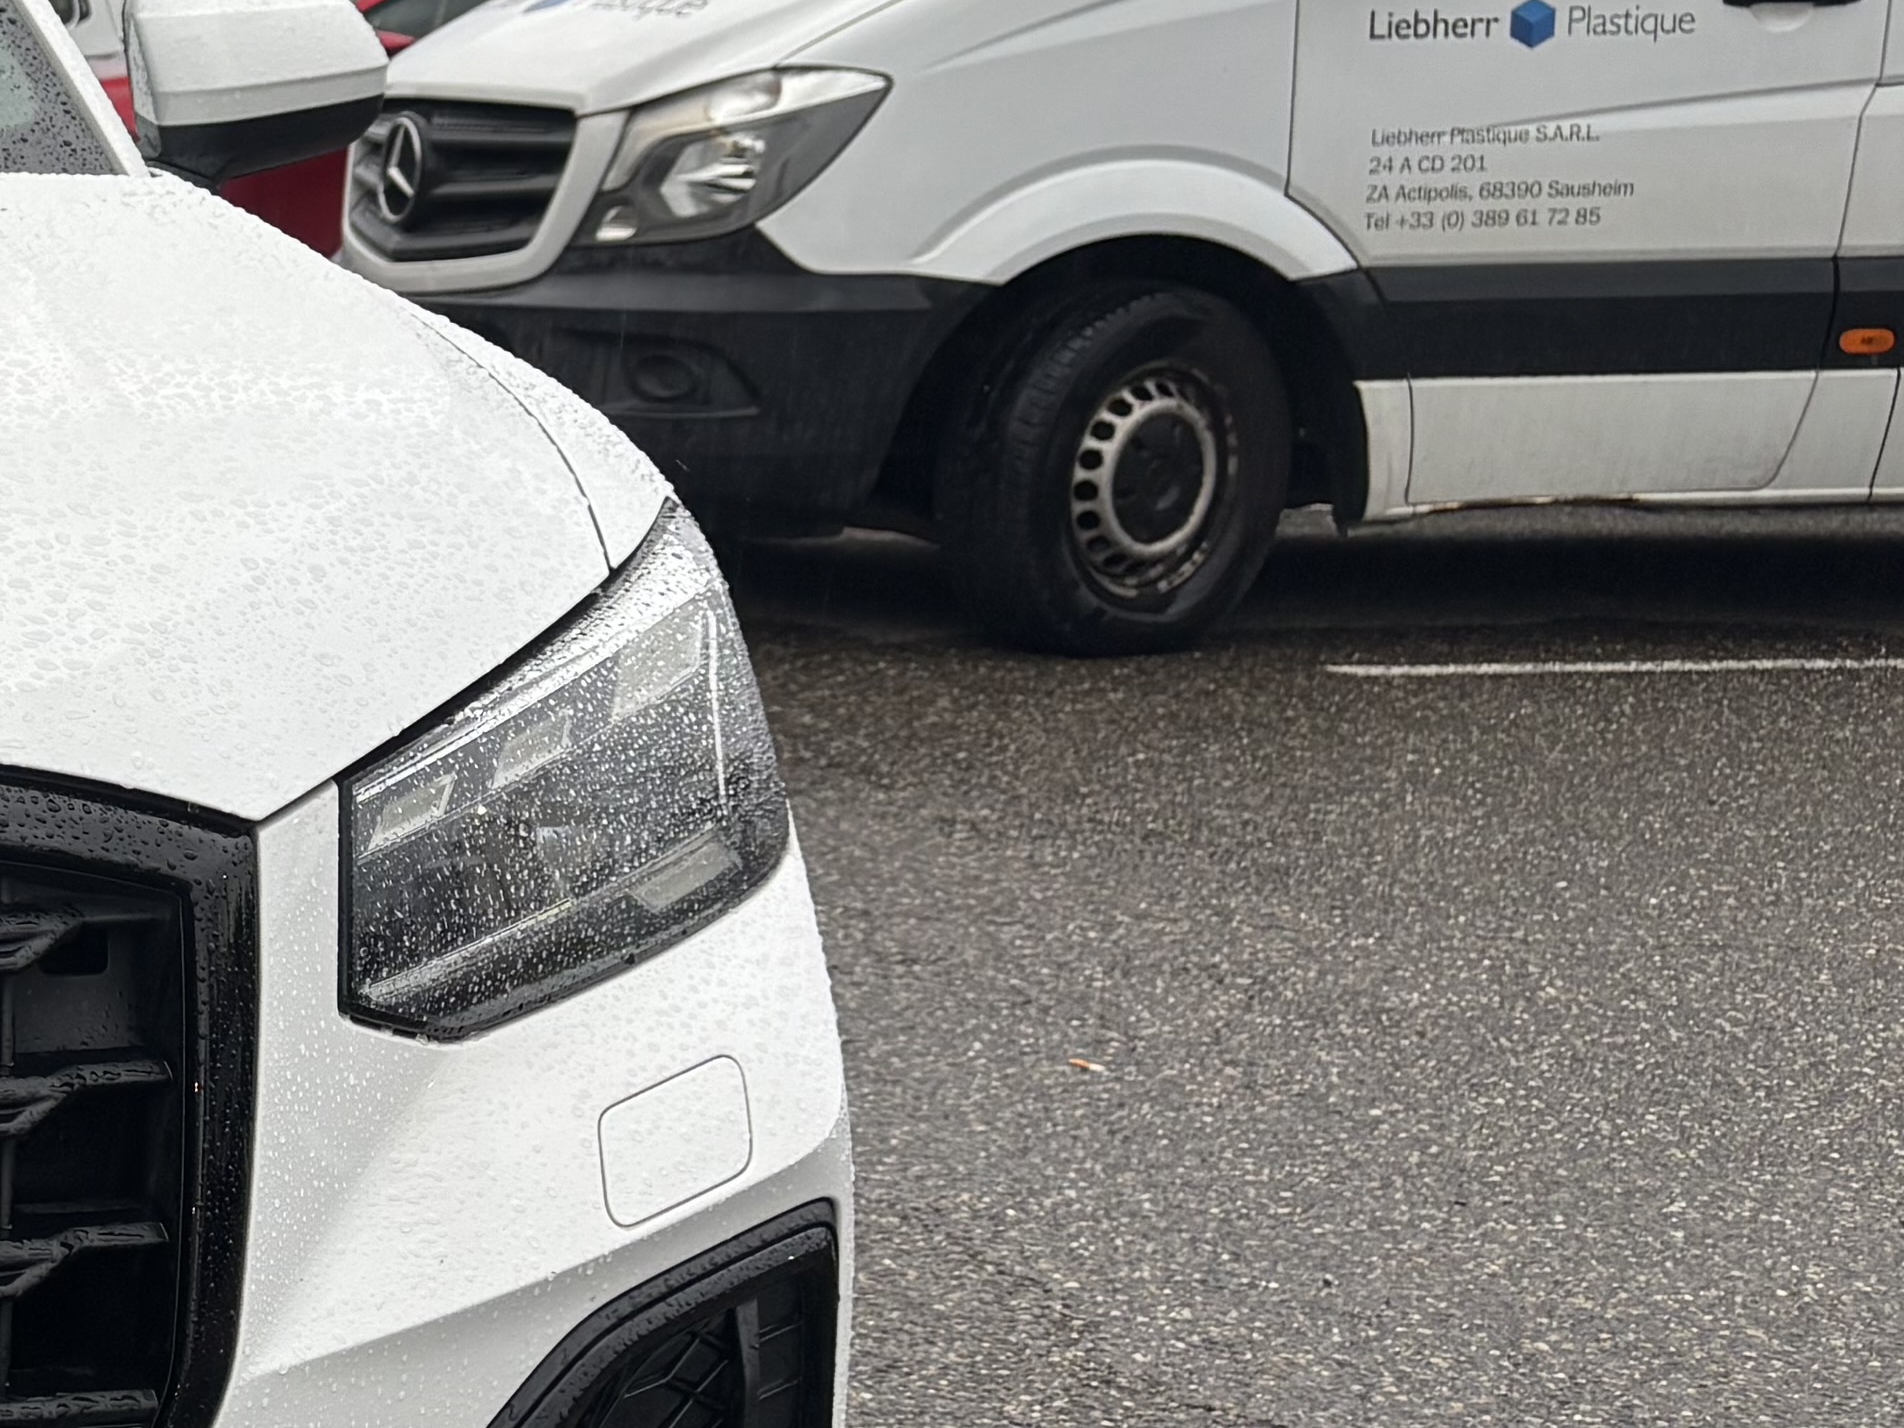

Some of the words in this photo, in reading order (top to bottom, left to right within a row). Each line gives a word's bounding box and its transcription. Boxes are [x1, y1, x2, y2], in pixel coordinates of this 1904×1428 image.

[1369, 8, 1500, 41] Liebherr
[1567, 4, 1696, 43] Plastique
[1371, 127, 1443, 148] Liebherr
[1449, 126, 1530, 148] Plastique
[1369, 156, 1393, 175] 24
[1399, 156, 1411, 174] A
[1418, 155, 1444, 173] CD
[1450, 154, 1487, 173] 201
[1365, 184, 1390, 204] ZA
[1478, 180, 1542, 201] 68390
[1547, 179, 1634, 199] Sausheim
[1364, 212, 1390, 231] Tel
[1396, 211, 1435, 230] +33
[1442, 210, 1465, 233] (0)
[1471, 209, 1510, 228] 389
[1516, 209, 1539, 227] 61
[1547, 208, 1570, 227] 72
[1574, 207, 1601, 226] 85
